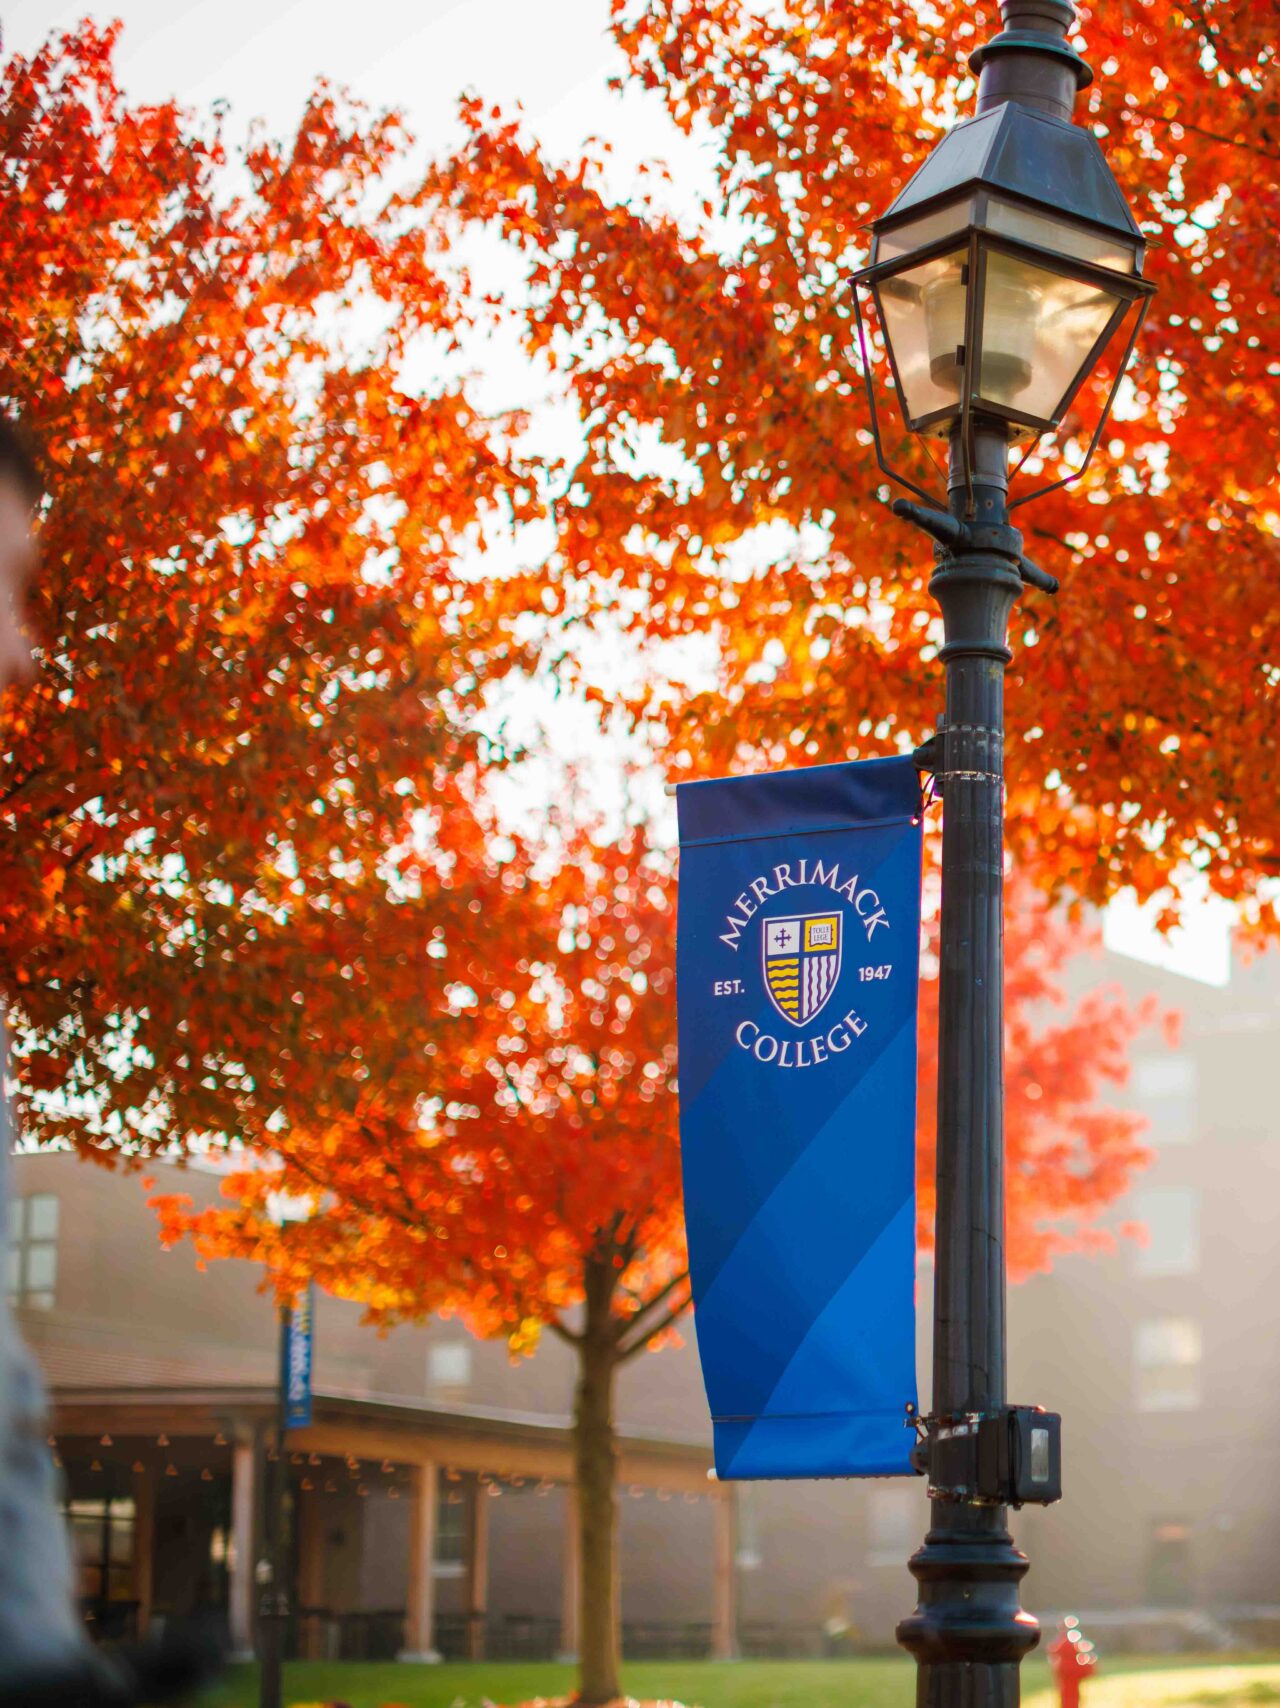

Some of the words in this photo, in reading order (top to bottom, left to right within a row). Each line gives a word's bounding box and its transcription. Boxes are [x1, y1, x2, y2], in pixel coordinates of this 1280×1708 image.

[719, 859, 890, 951] MERRIMACK
[813, 934, 828, 942] LEGE
[858, 965, 892, 982] 1947
[714, 980, 745, 996] EST.
[736, 1009, 868, 1068] COLLEGE
